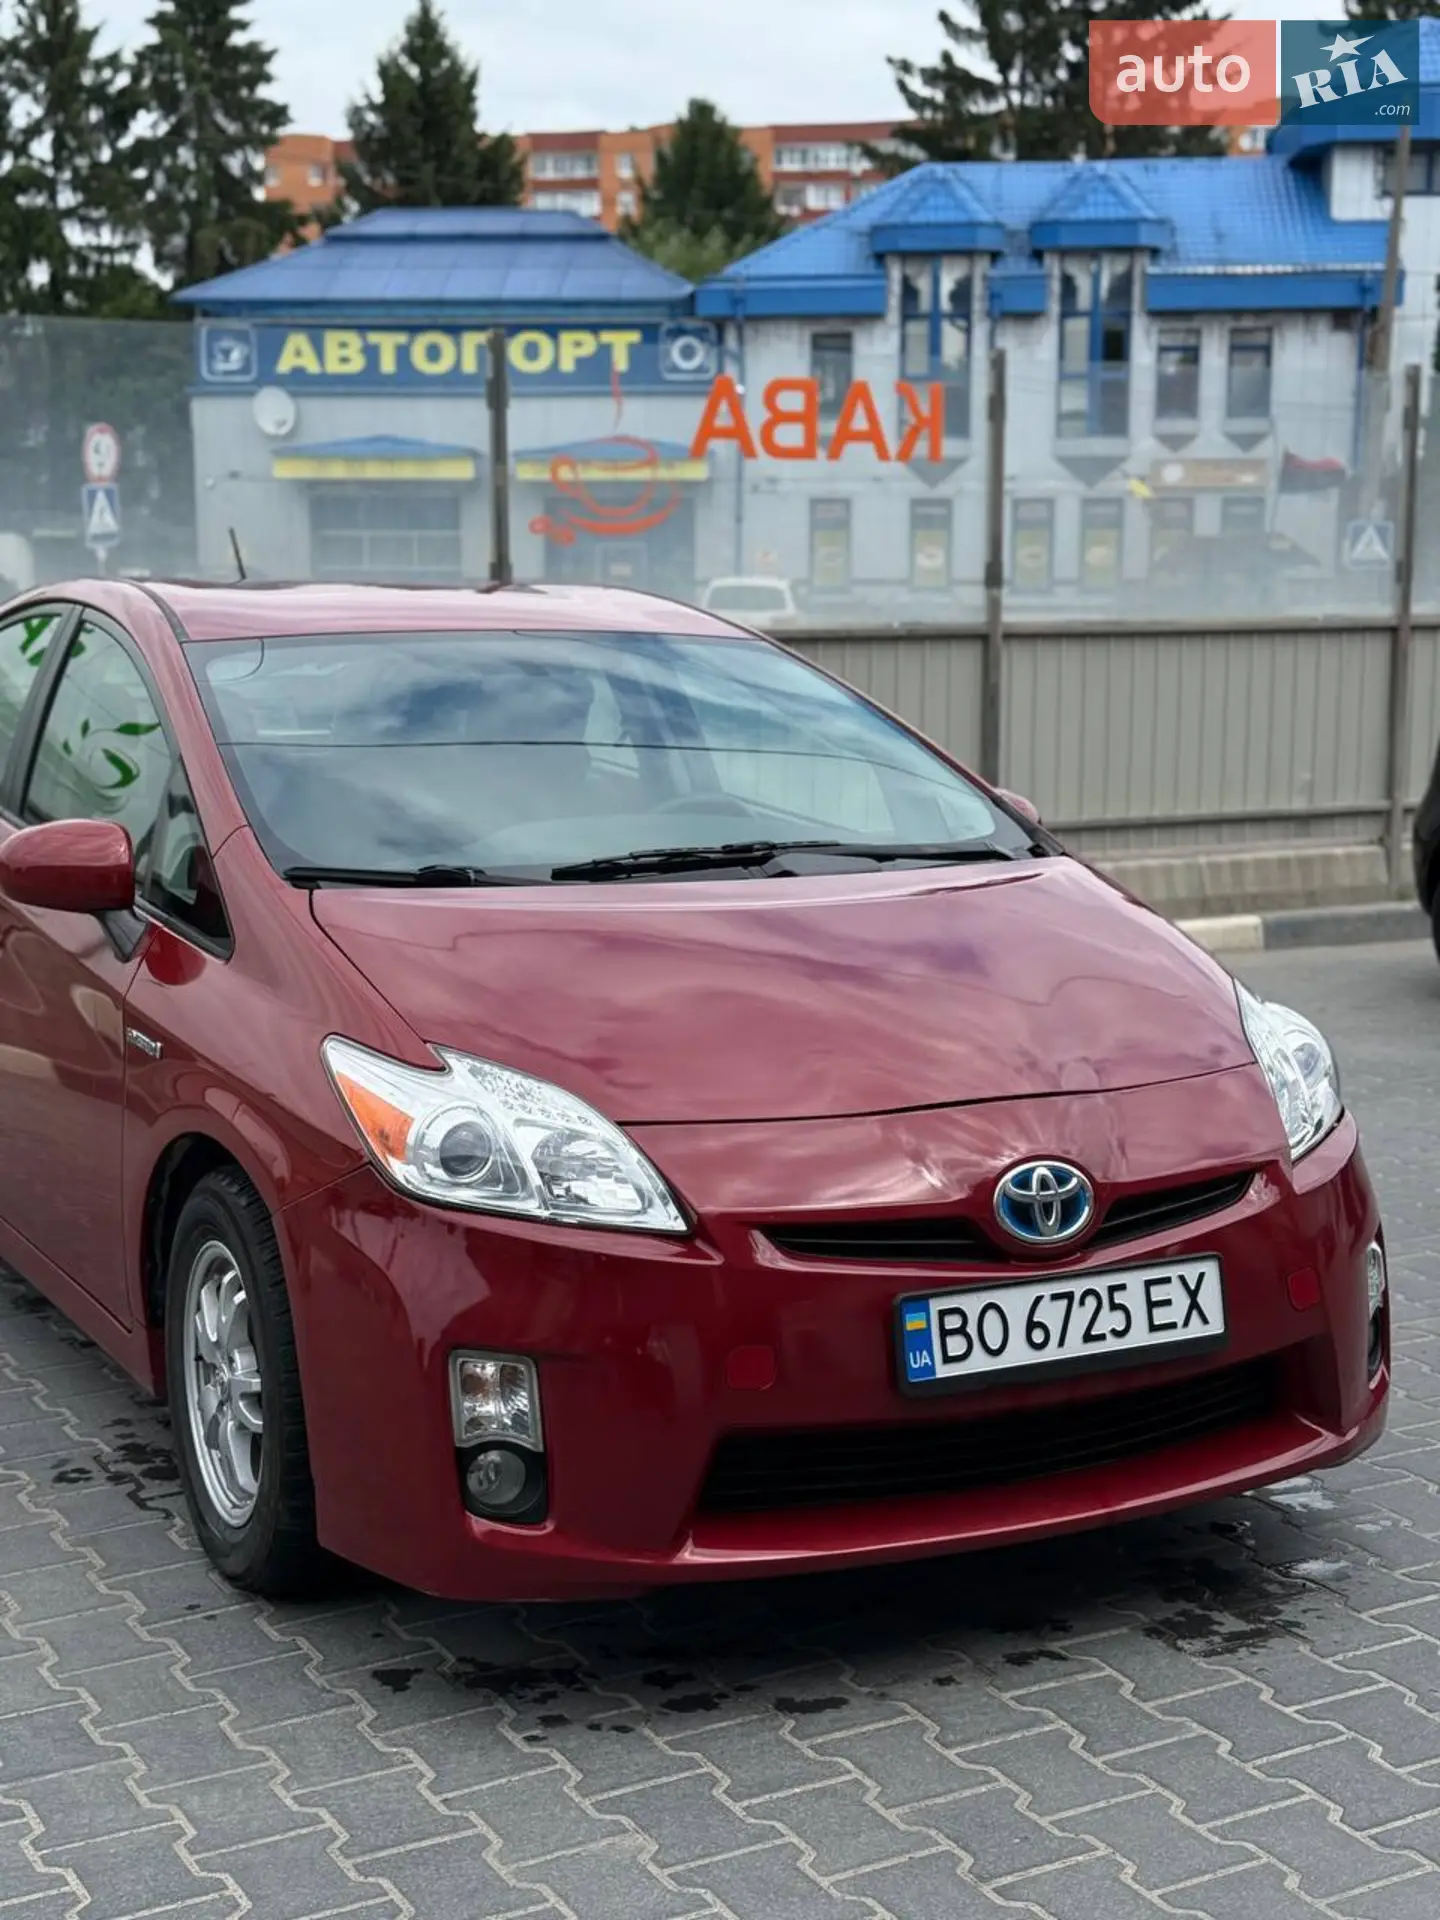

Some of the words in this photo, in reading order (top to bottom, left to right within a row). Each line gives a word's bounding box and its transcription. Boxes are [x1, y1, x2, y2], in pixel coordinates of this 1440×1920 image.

[938, 1302, 1010, 1364] BO
[1025, 1283, 1132, 1351] 6725
[1143, 1271, 1210, 1333] EX
[909, 1351, 933, 1369] UA
